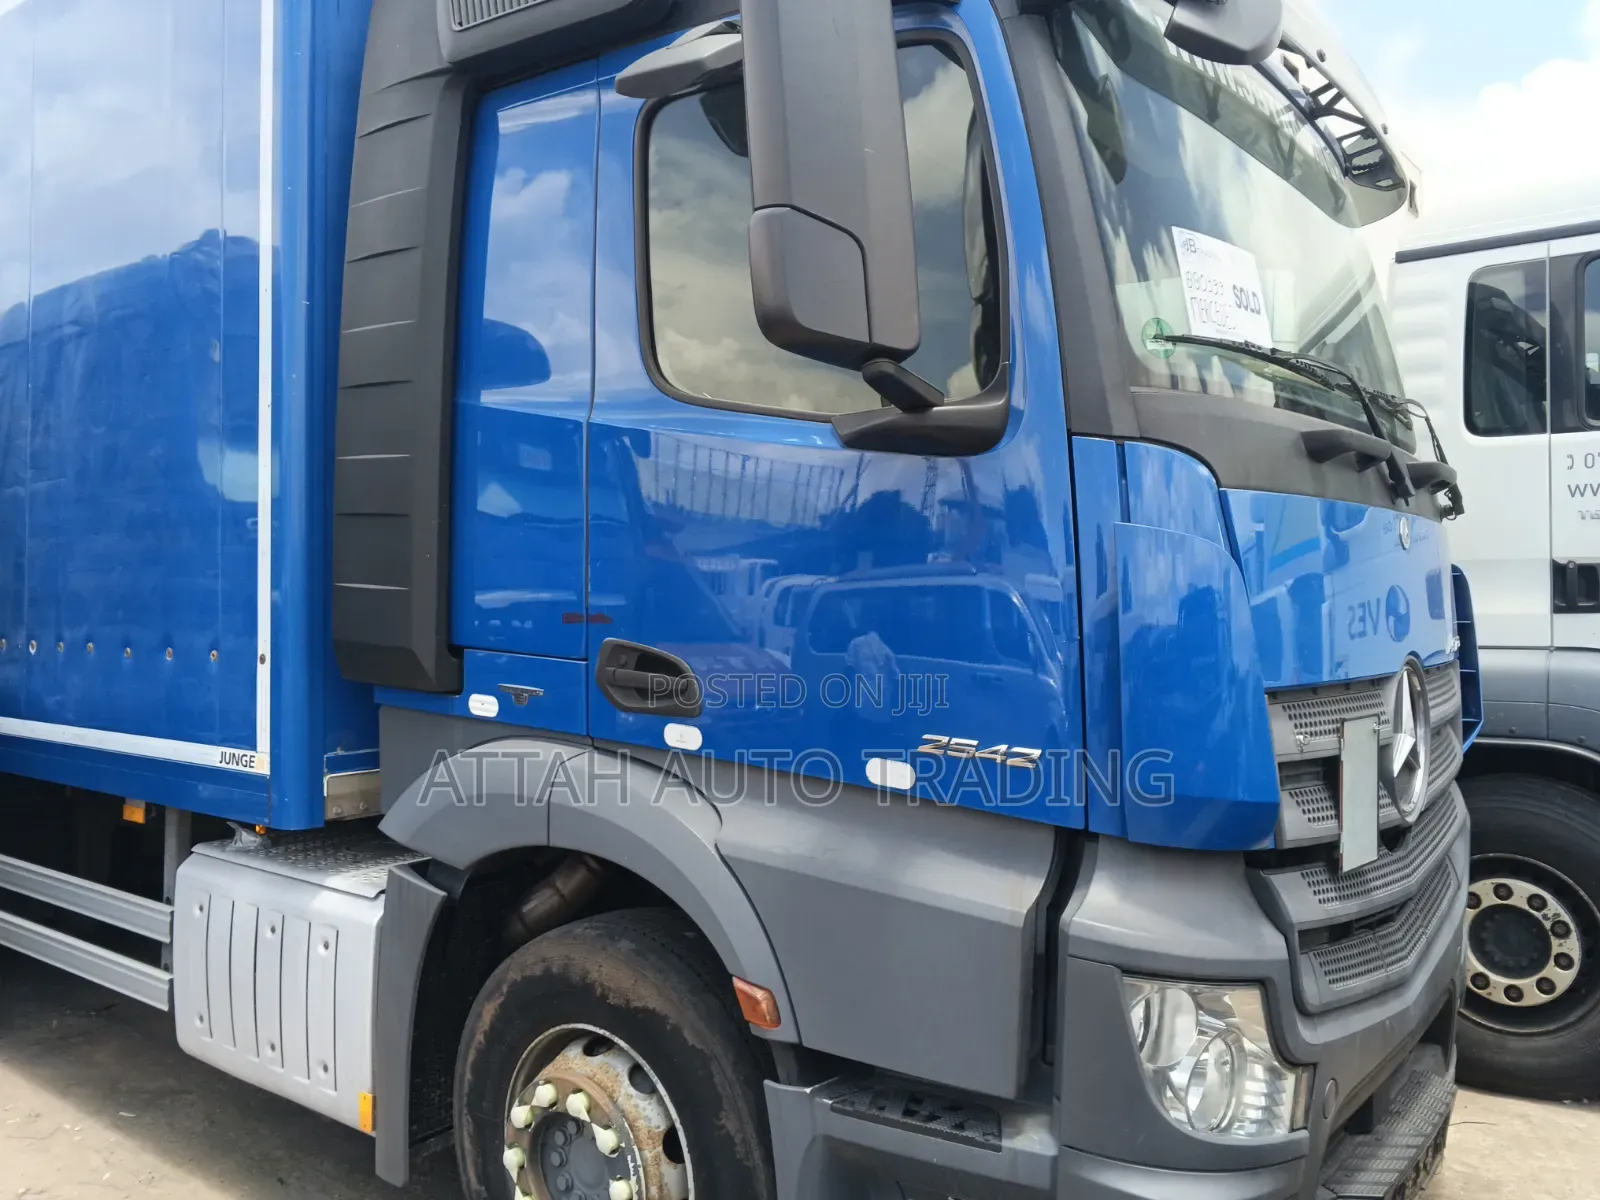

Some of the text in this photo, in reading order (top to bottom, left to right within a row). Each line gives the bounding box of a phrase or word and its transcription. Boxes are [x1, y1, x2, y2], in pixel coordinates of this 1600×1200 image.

[1232, 284, 1261, 315] SOLD
[219, 750, 256, 769] JUNGE
[917, 733, 1042, 769] 2542
